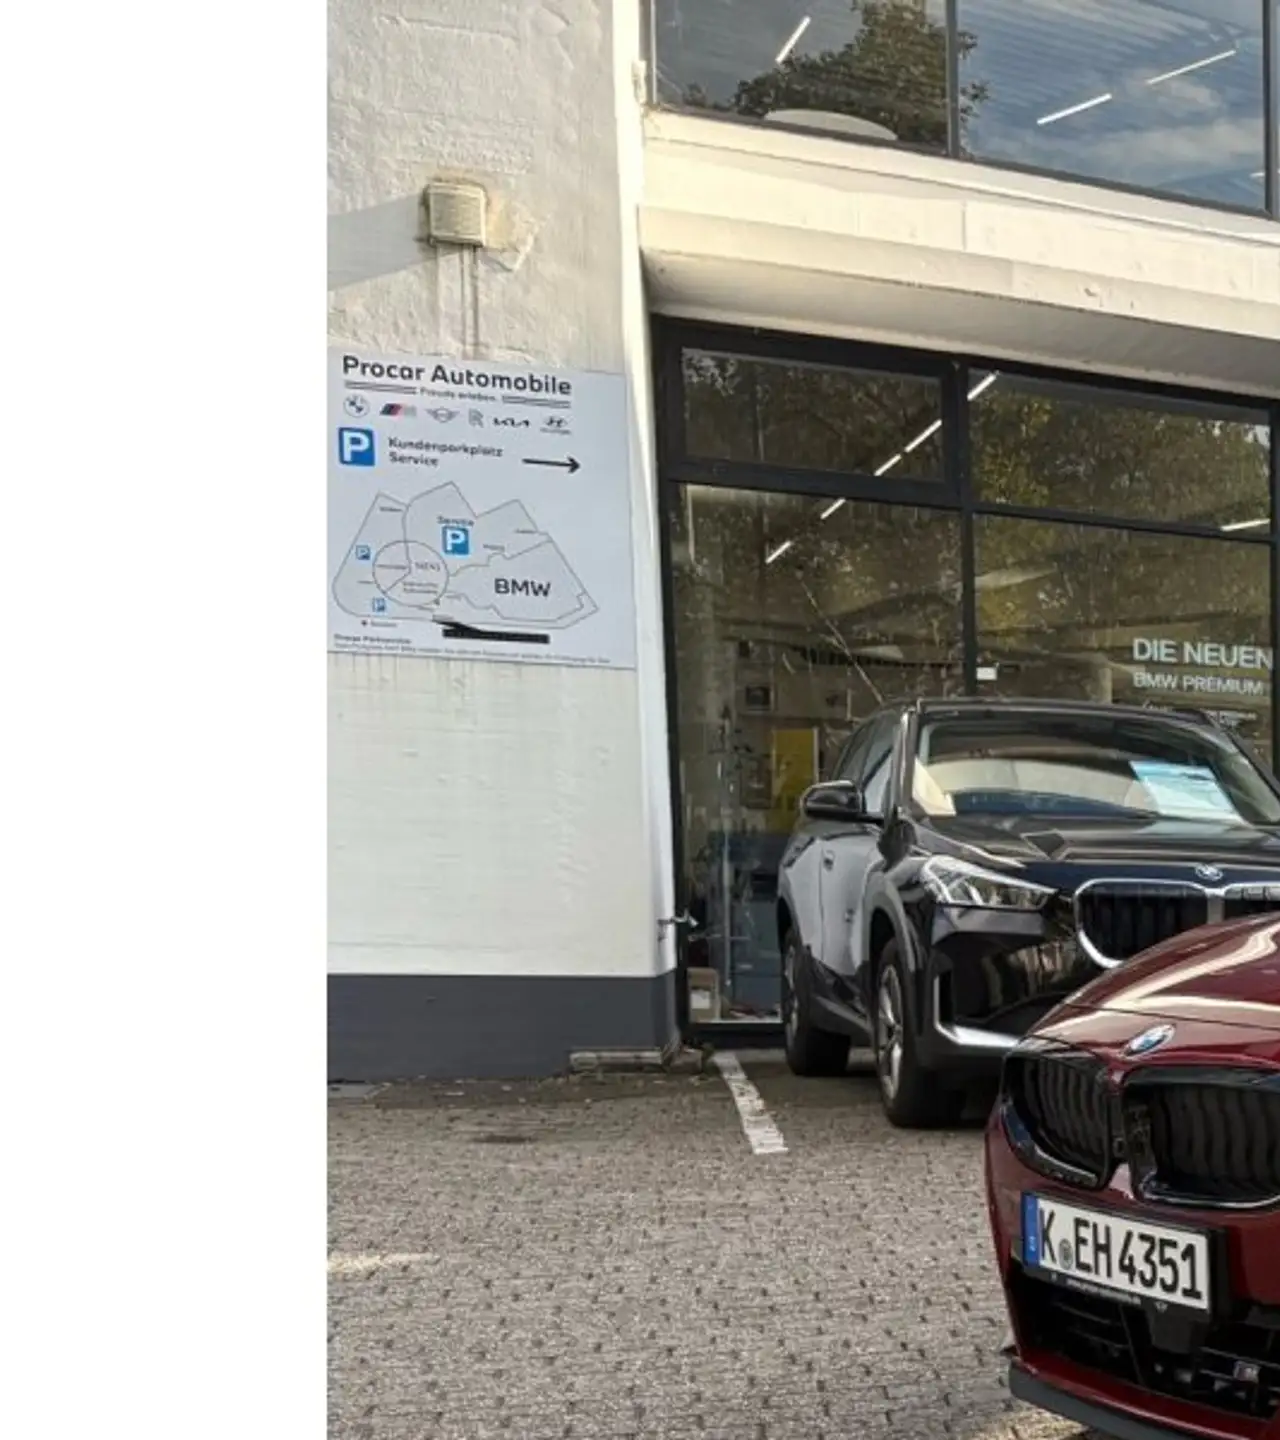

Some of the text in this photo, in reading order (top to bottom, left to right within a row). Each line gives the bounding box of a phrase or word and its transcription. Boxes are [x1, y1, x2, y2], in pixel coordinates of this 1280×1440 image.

[342, 355, 572, 395] Procar Automobile
[388, 436, 504, 458] Kundenparkplatz
[388, 451, 439, 467] Service
[436, 515, 475, 528] Service
[494, 577, 552, 597] BMW
[1132, 637, 1178, 664] DIE
[1182, 642, 1273, 672] NEUEN
[1133, 671, 1179, 691] BMW
[1182, 675, 1264, 696] PREMIUM
[1039, 1207, 1057, 1265] K
[1074, 1216, 1113, 1280] EH
[1118, 1230, 1203, 1301] 4351
